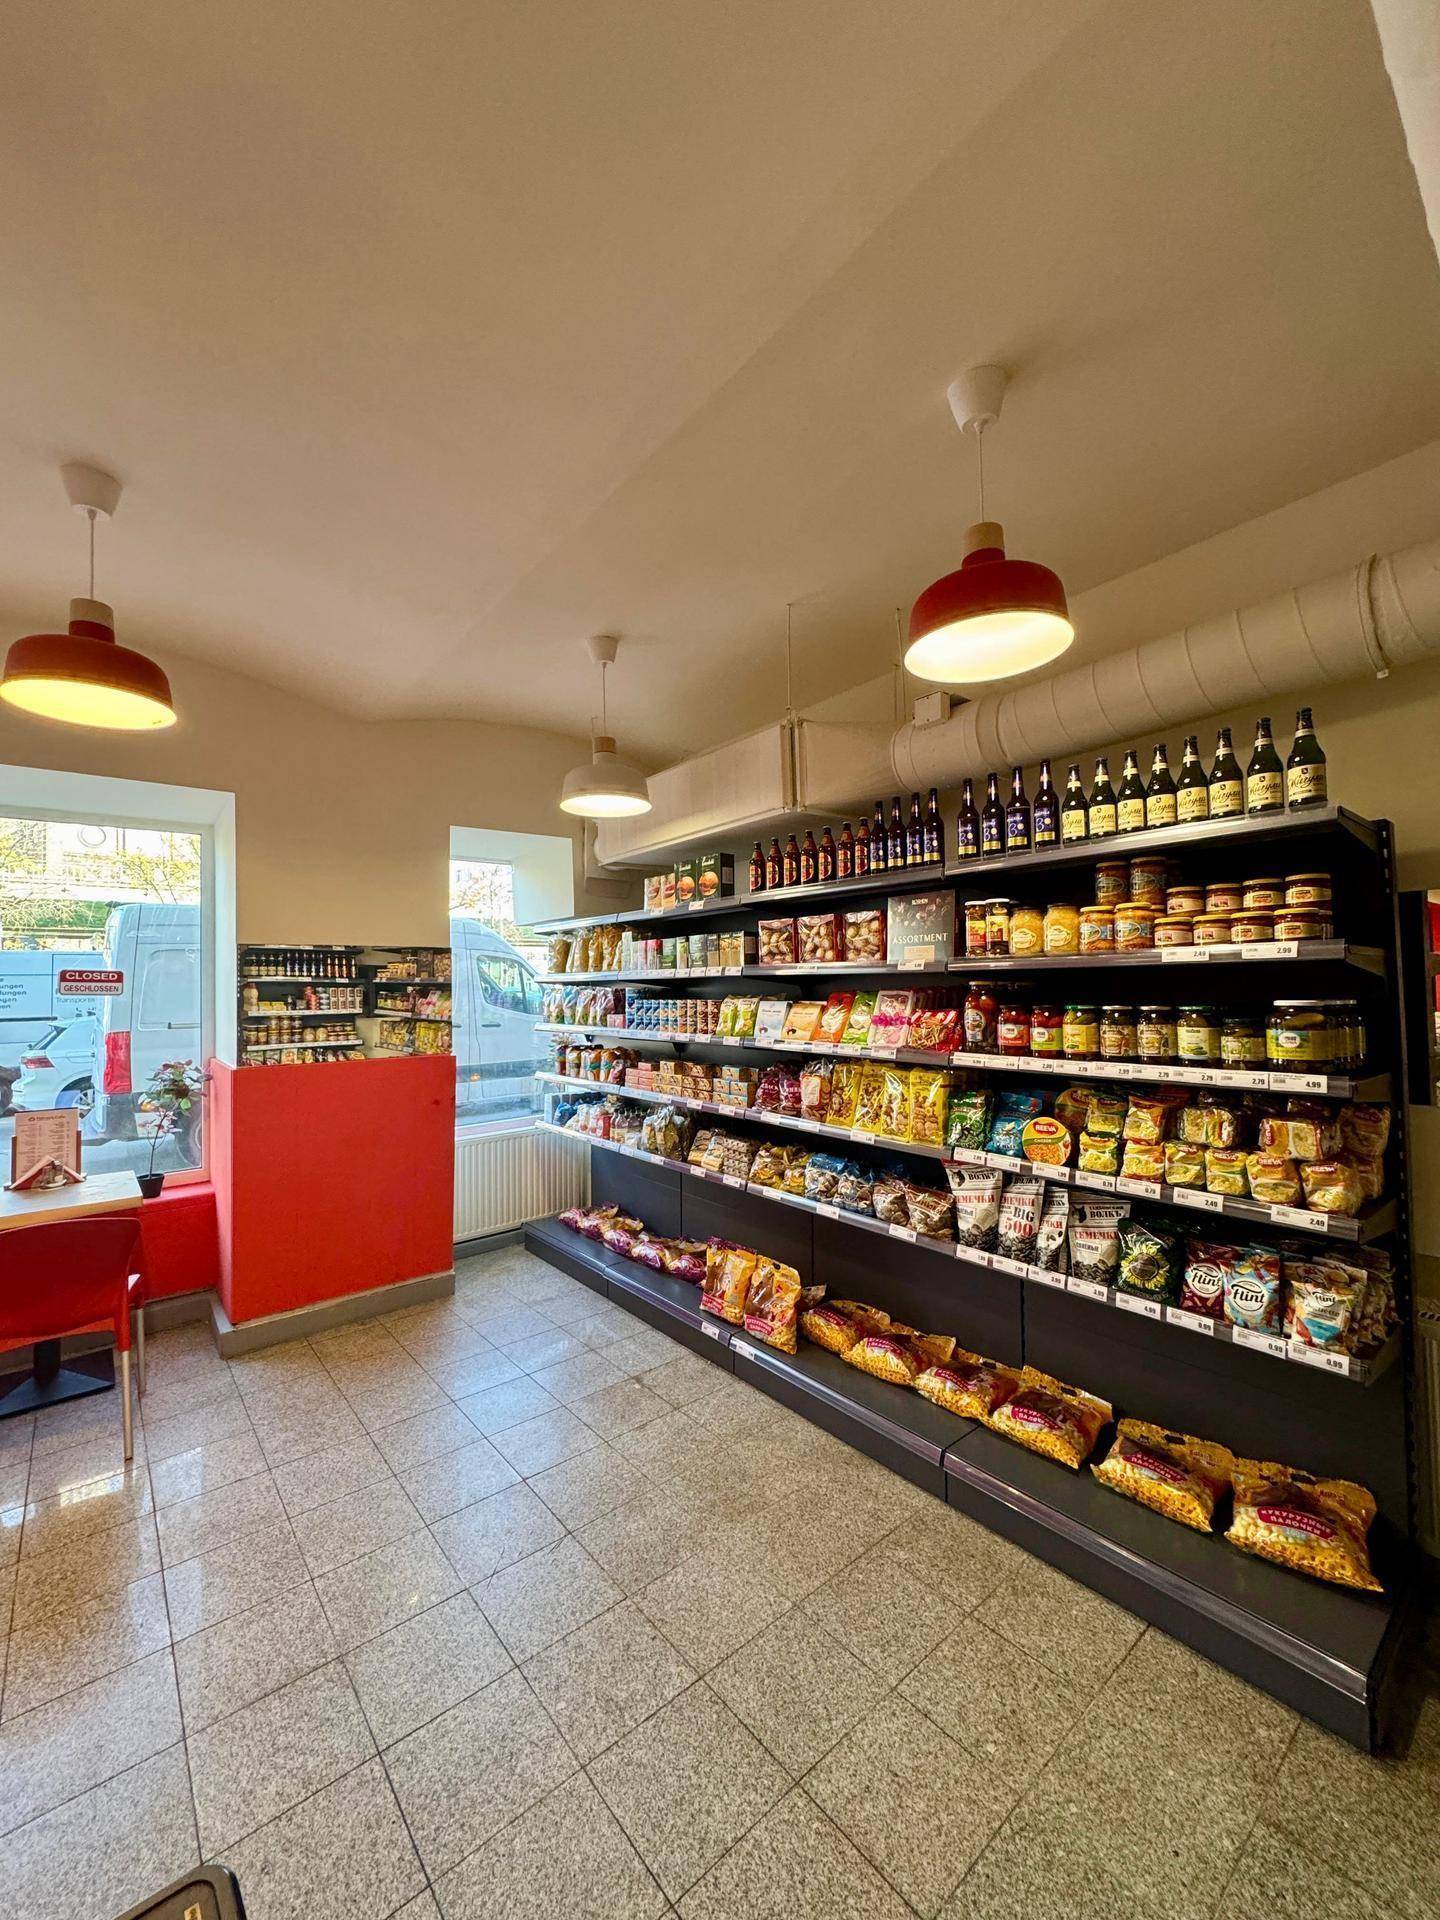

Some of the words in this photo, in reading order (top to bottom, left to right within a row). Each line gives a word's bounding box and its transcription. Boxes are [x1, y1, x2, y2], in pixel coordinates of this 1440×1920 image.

[892, 932, 949, 945] ASSORTMENT
[1276, 946, 1292, 954] 2.99
[65, 971, 118, 981] CLOSED
[63, 984, 120, 993] GESCHLOSSEN
[1305, 1081, 1322, 1089] 4.99
[1035, 1124, 1057, 1133] REEVA
[1204, 1199, 1218, 1208] 2.49
[1013, 1206, 1035, 1223] BIG
[1090, 1210, 1122, 1218] ВОЛКЪ
[1309, 1217, 1325, 1227] 2.49
[1005, 1220, 1033, 1237] 500
[1192, 1269, 1221, 1287] flint
[1232, 1287, 1265, 1304] flint
[1268, 1342, 1283, 1354] 0.99
[1326, 1358, 1343, 1369] 0.99
[1261, 1509, 1331, 1534] КУКУРУЗНЫЕ
[1270, 1515, 1320, 1535] ПАЛОЧКИ
